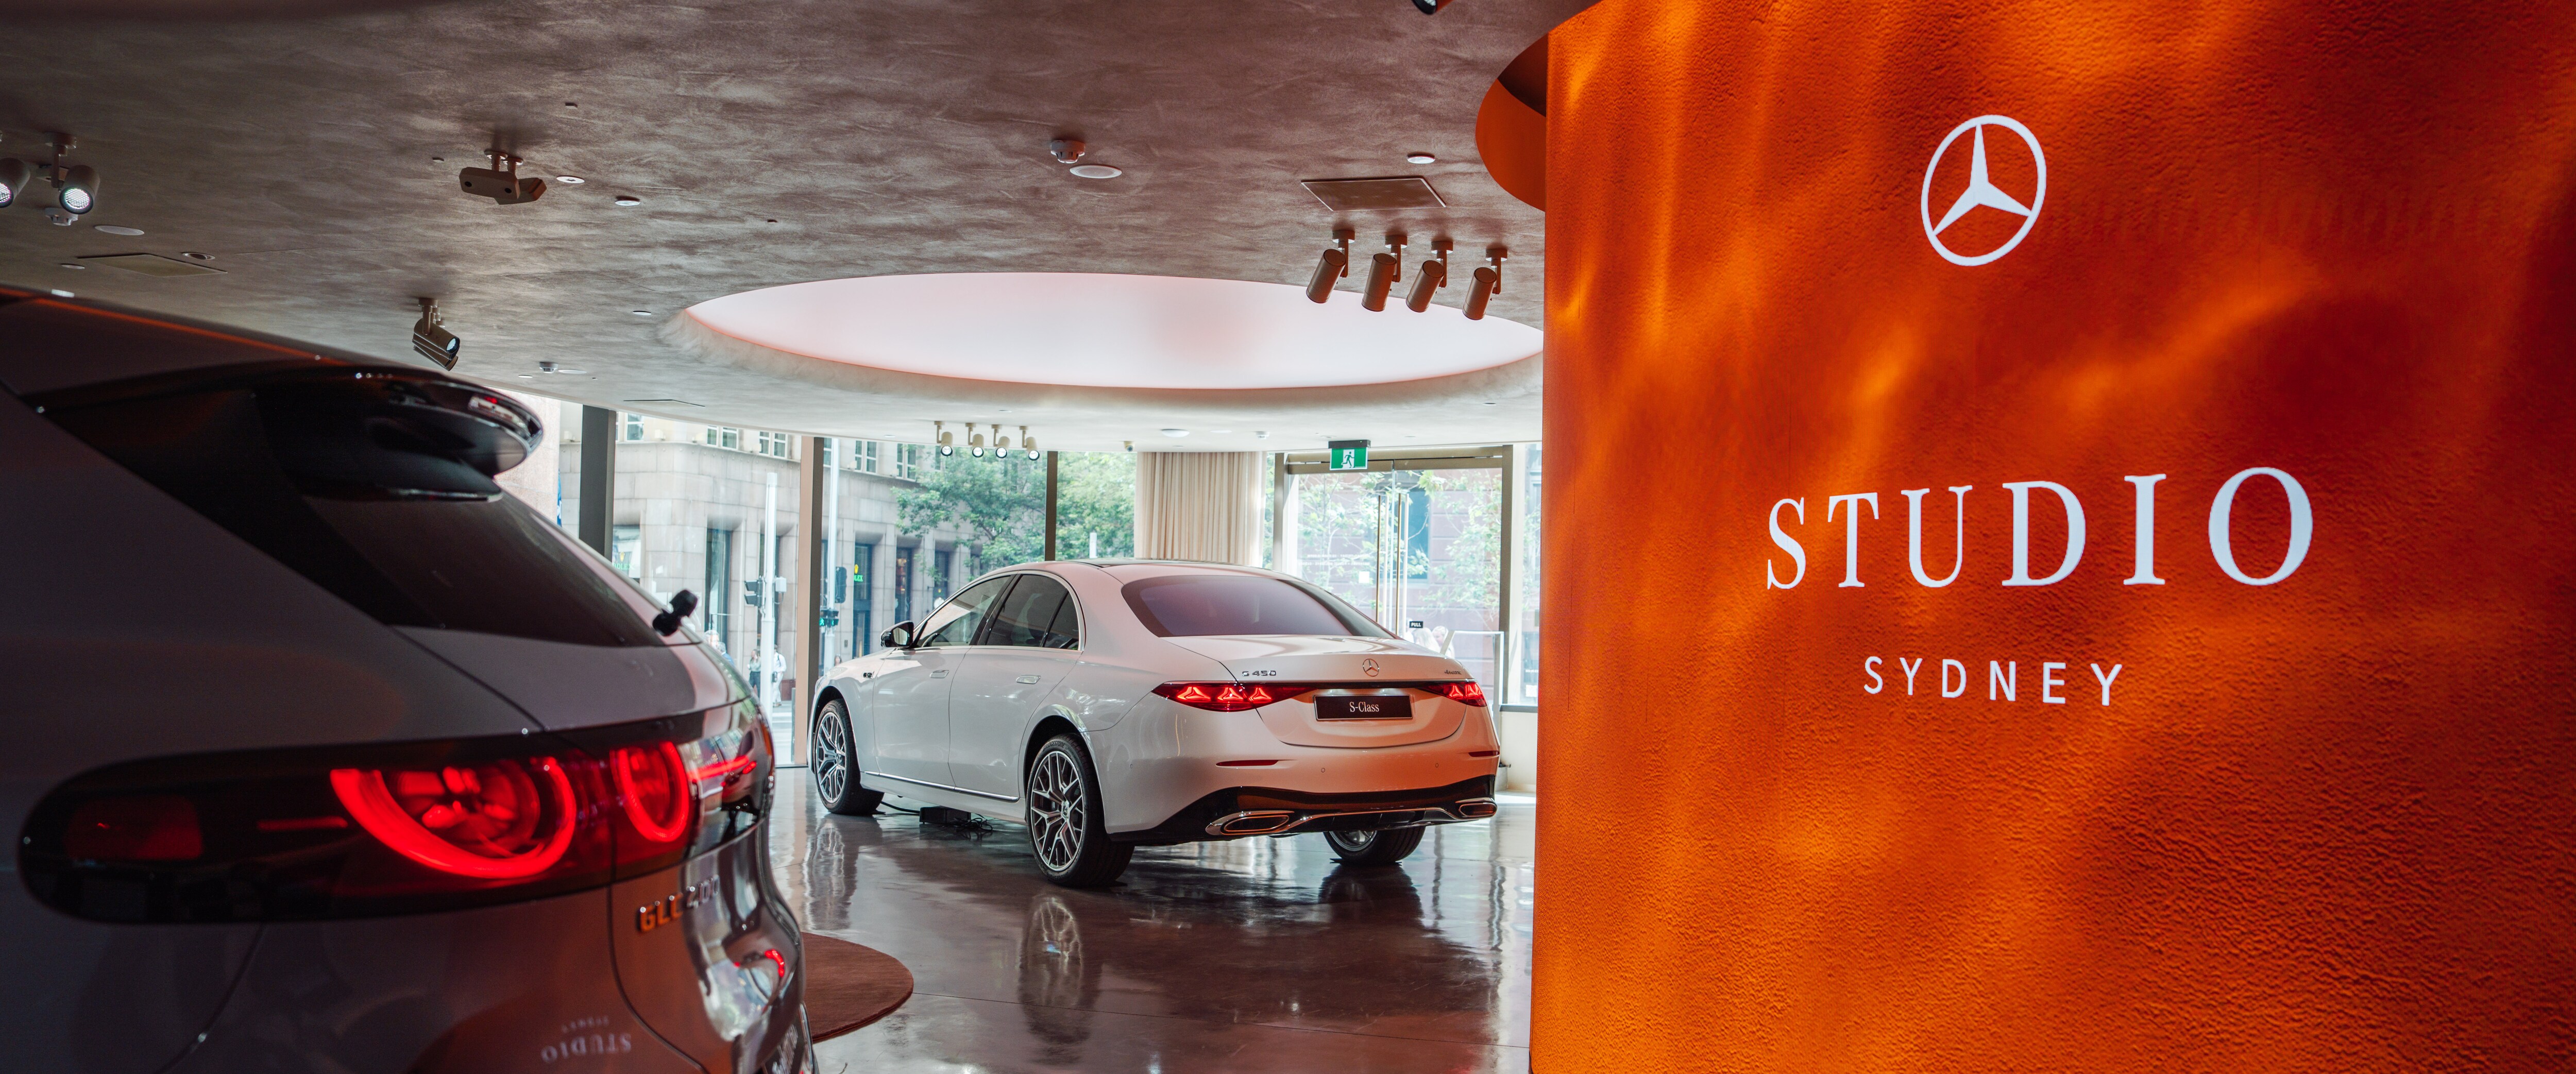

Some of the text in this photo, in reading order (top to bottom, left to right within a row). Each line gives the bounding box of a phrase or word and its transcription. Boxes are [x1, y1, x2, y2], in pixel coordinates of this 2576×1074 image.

[1767, 466, 2314, 590] STUDIO
[1863, 656, 2122, 706] SYDNEY
[1349, 701, 1379, 712] S-Class
[639, 892, 683, 932] GLC
